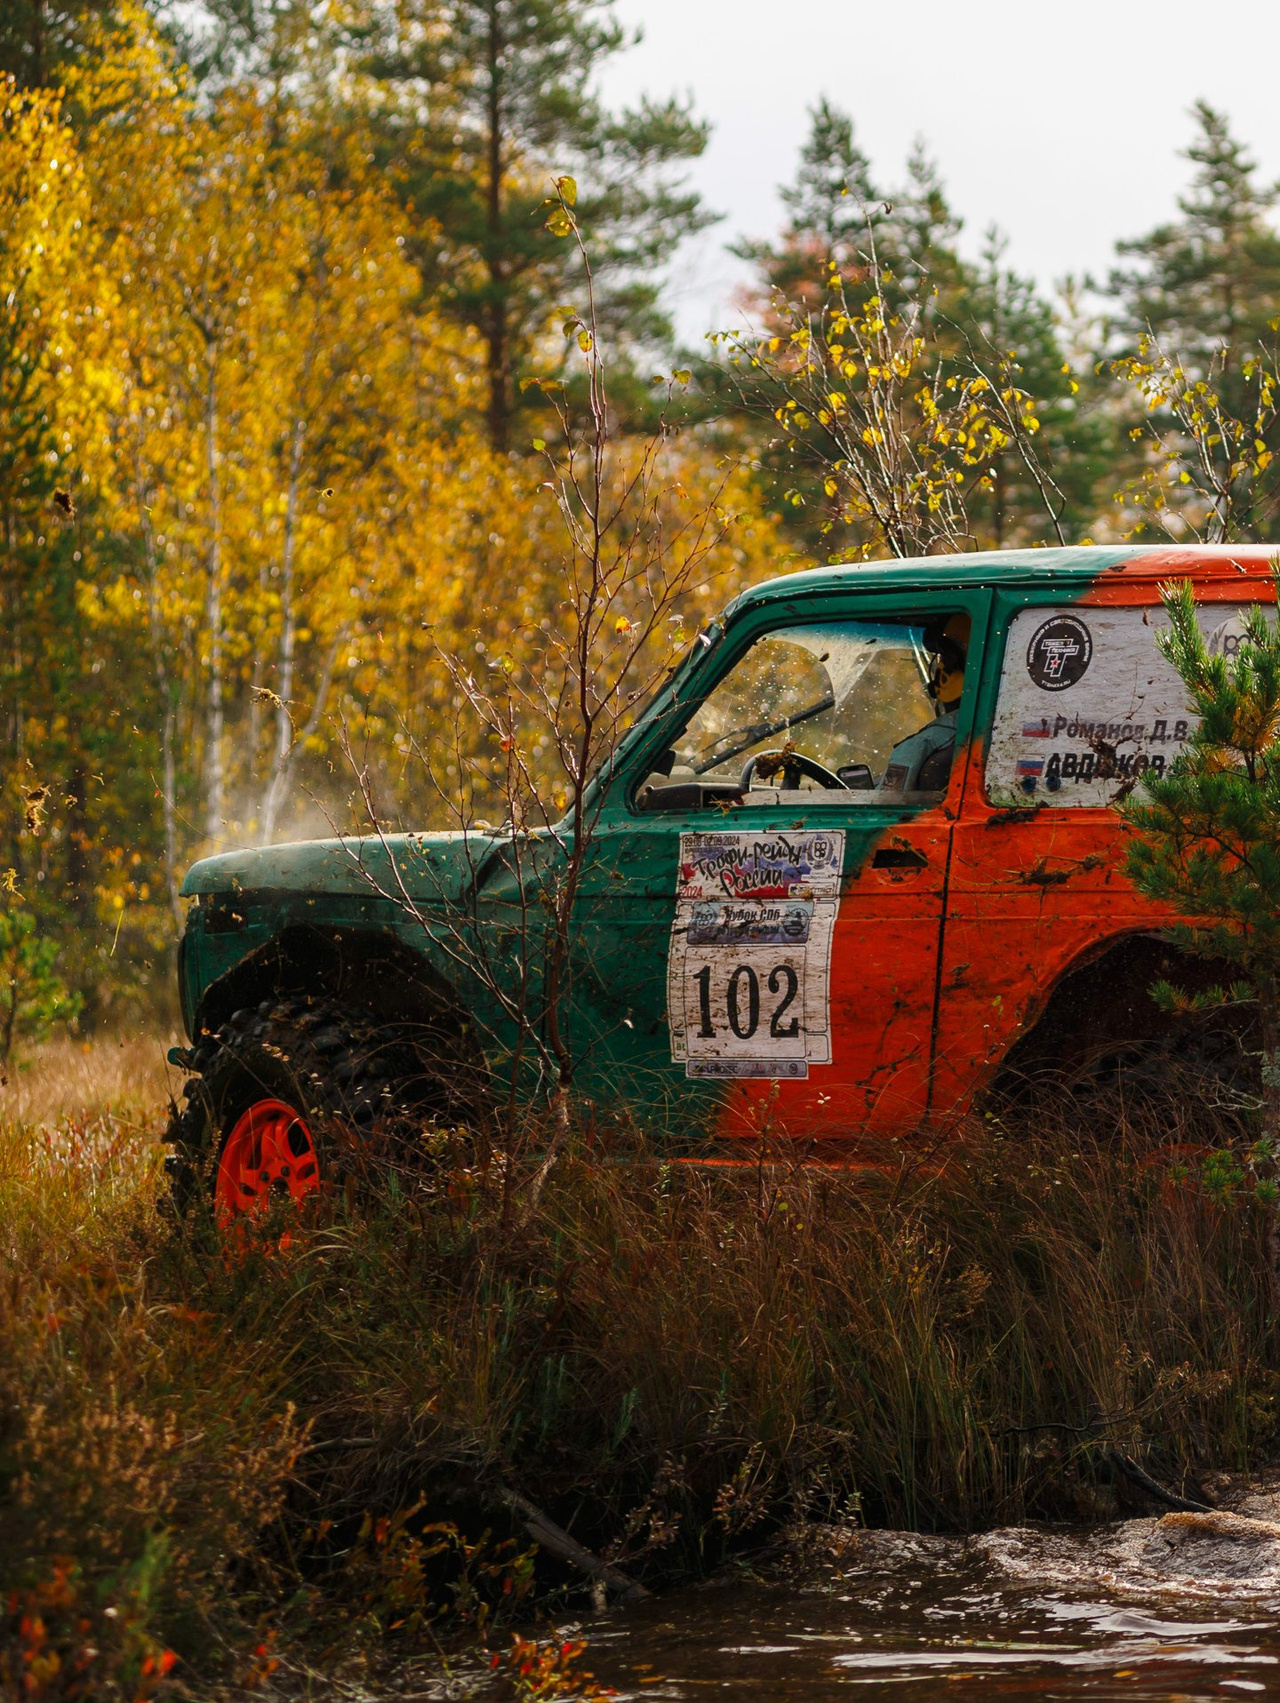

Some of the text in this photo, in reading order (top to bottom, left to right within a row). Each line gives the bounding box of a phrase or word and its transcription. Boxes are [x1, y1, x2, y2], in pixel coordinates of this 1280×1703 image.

[1053, 717, 1145, 740] Романов
[692, 835, 801, 880] Трофи-рейды
[682, 886, 703, 899] 2024
[720, 867, 783, 898] России
[693, 965, 799, 1040] 102
